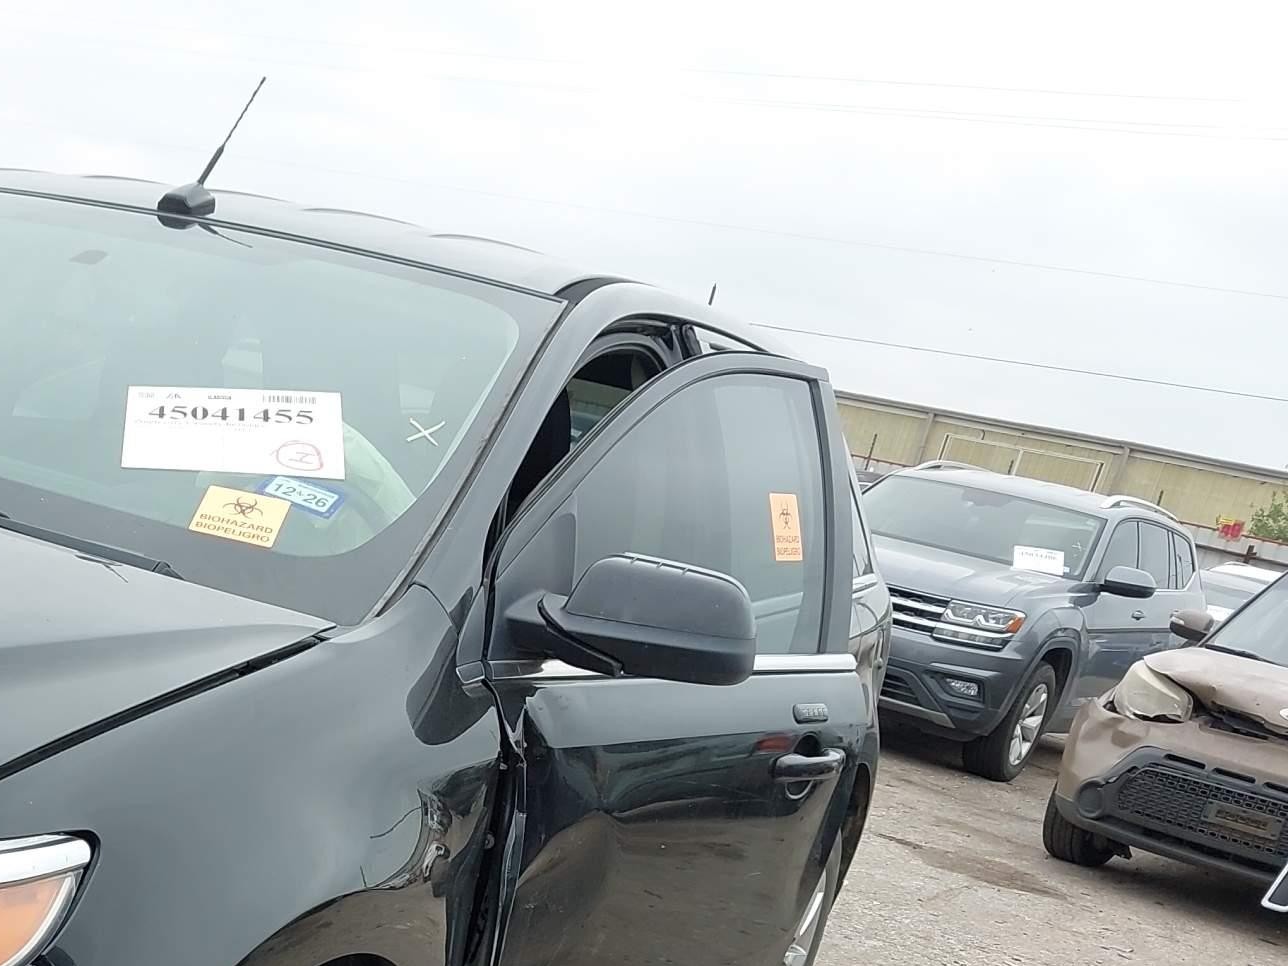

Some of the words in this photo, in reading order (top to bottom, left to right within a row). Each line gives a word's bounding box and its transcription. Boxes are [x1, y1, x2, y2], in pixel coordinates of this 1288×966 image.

[148, 405, 315, 425] 45041455
[195, 521, 270, 543] BIOPELIGRO
[199, 513, 274, 534] BIOHAZARD
